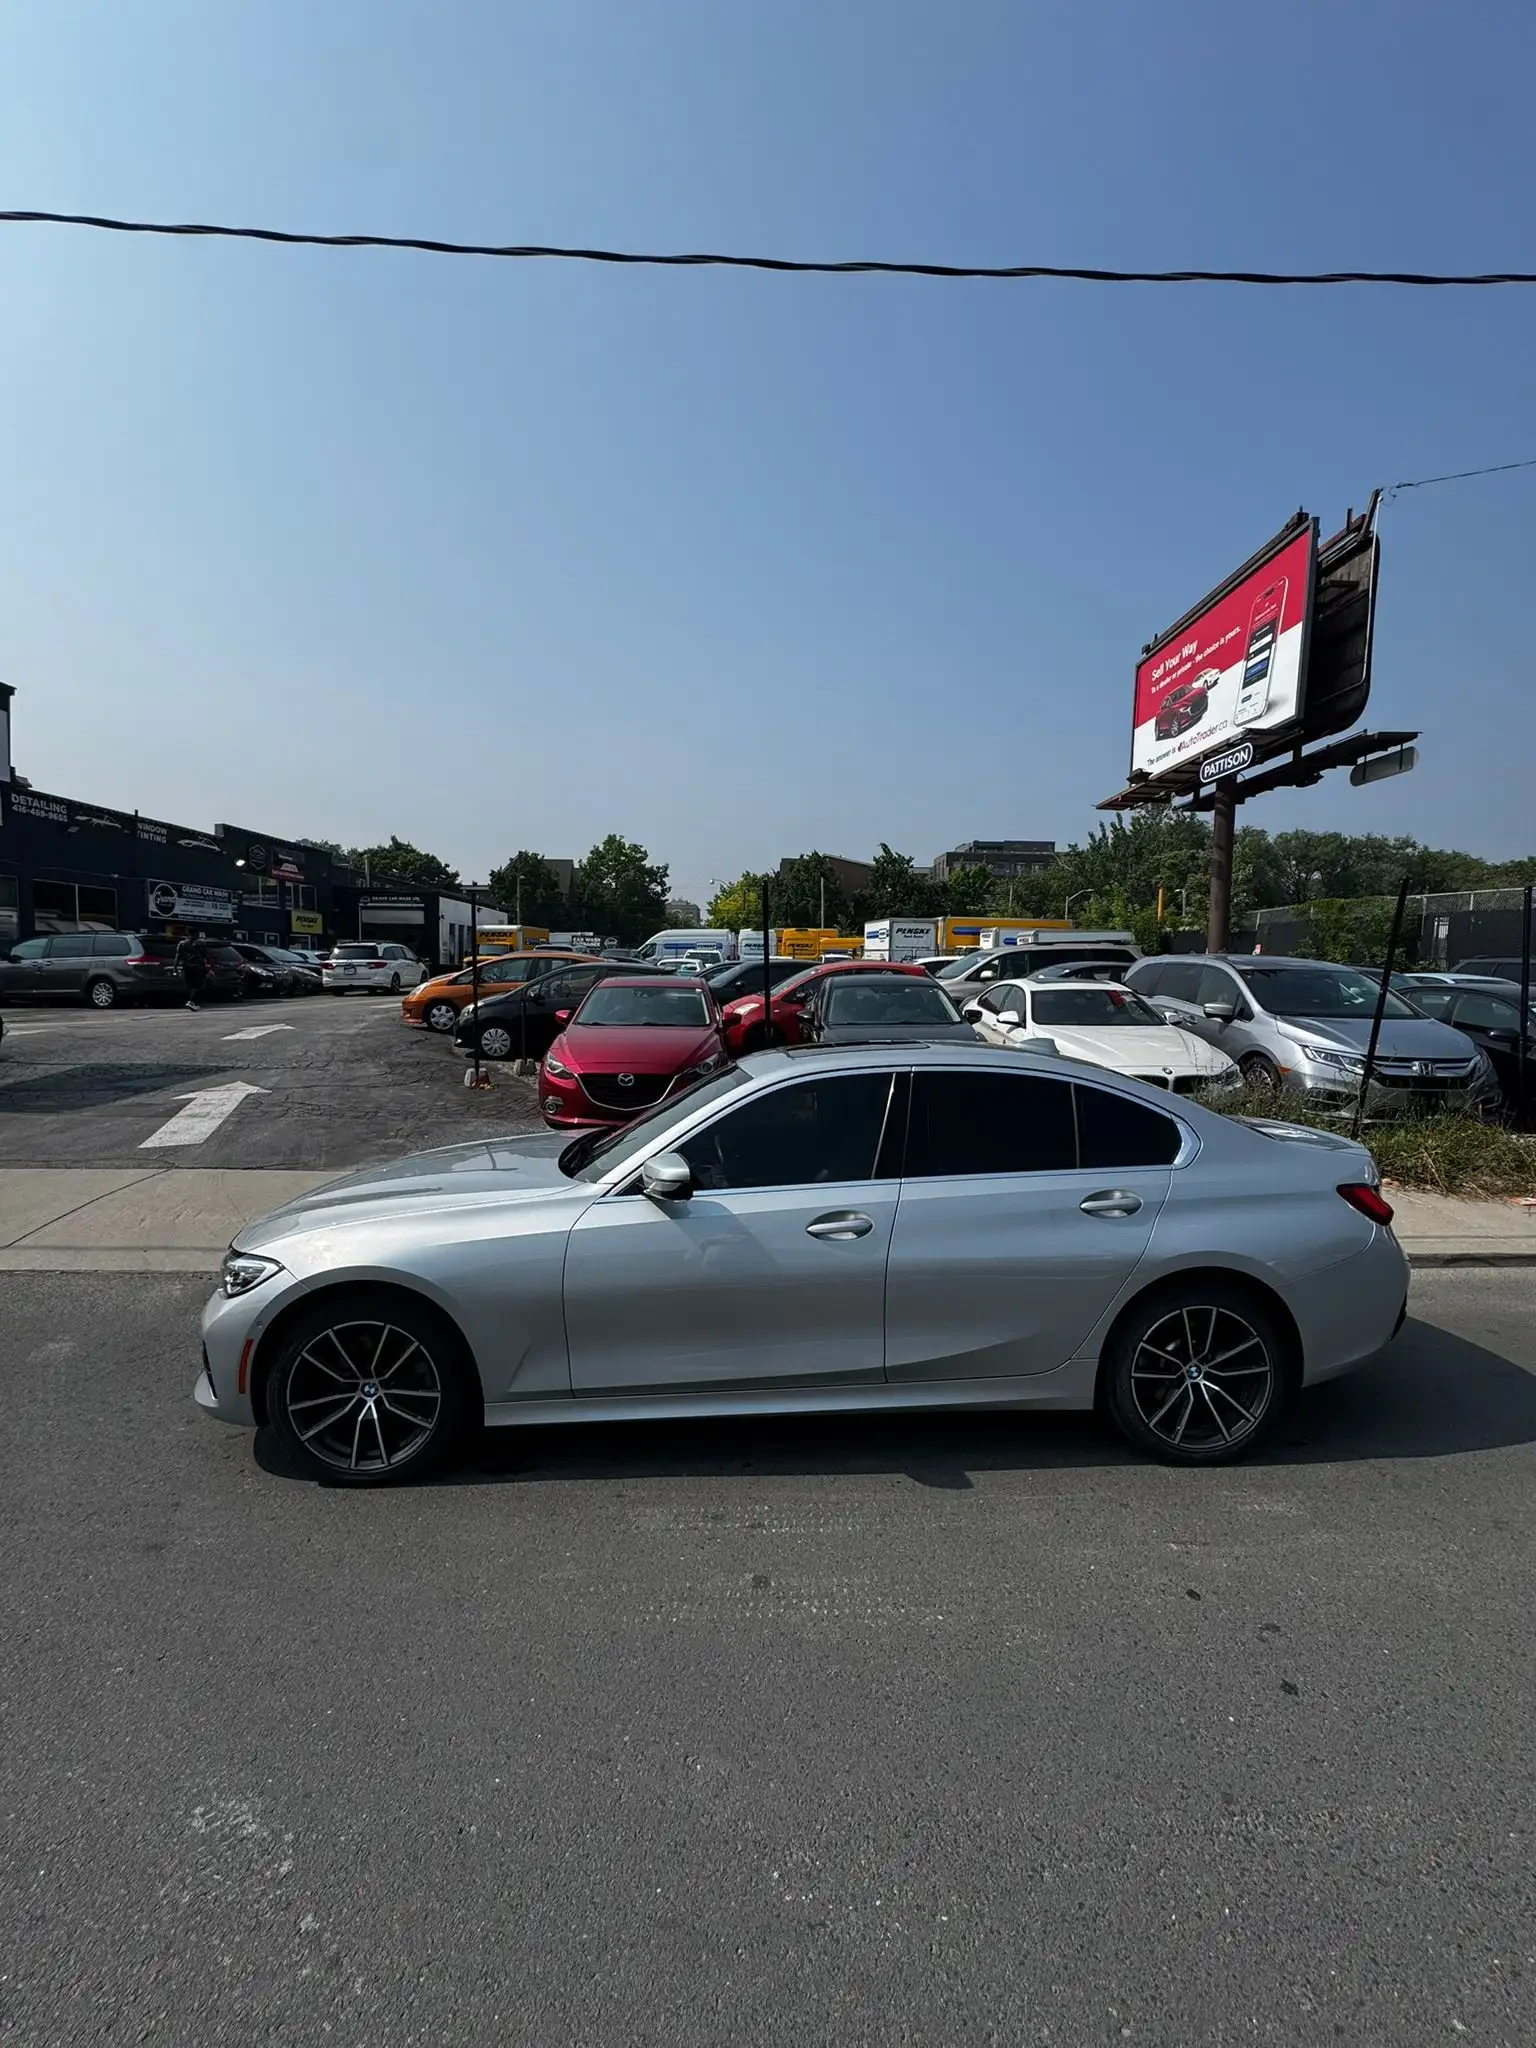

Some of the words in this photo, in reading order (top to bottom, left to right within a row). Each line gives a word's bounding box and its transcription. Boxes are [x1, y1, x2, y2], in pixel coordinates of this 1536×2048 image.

[1203, 641, 1220, 658] choice
[1151, 663, 1164, 682] Sell
[1165, 652, 1182, 672] Your
[1181, 640, 1198, 659] Way
[1147, 757, 1155, 767] The
[1204, 747, 1245, 778] PATTISON
[11, 793, 68, 814] DETAILING
[137, 822, 168, 836] WINDOW
[137, 830, 167, 844] TINTING
[182, 885, 202, 894] GRAND
[202, 888, 214, 896] CAR
[214, 890, 229, 898] WASH
[896, 927, 932, 936] PENSKE
